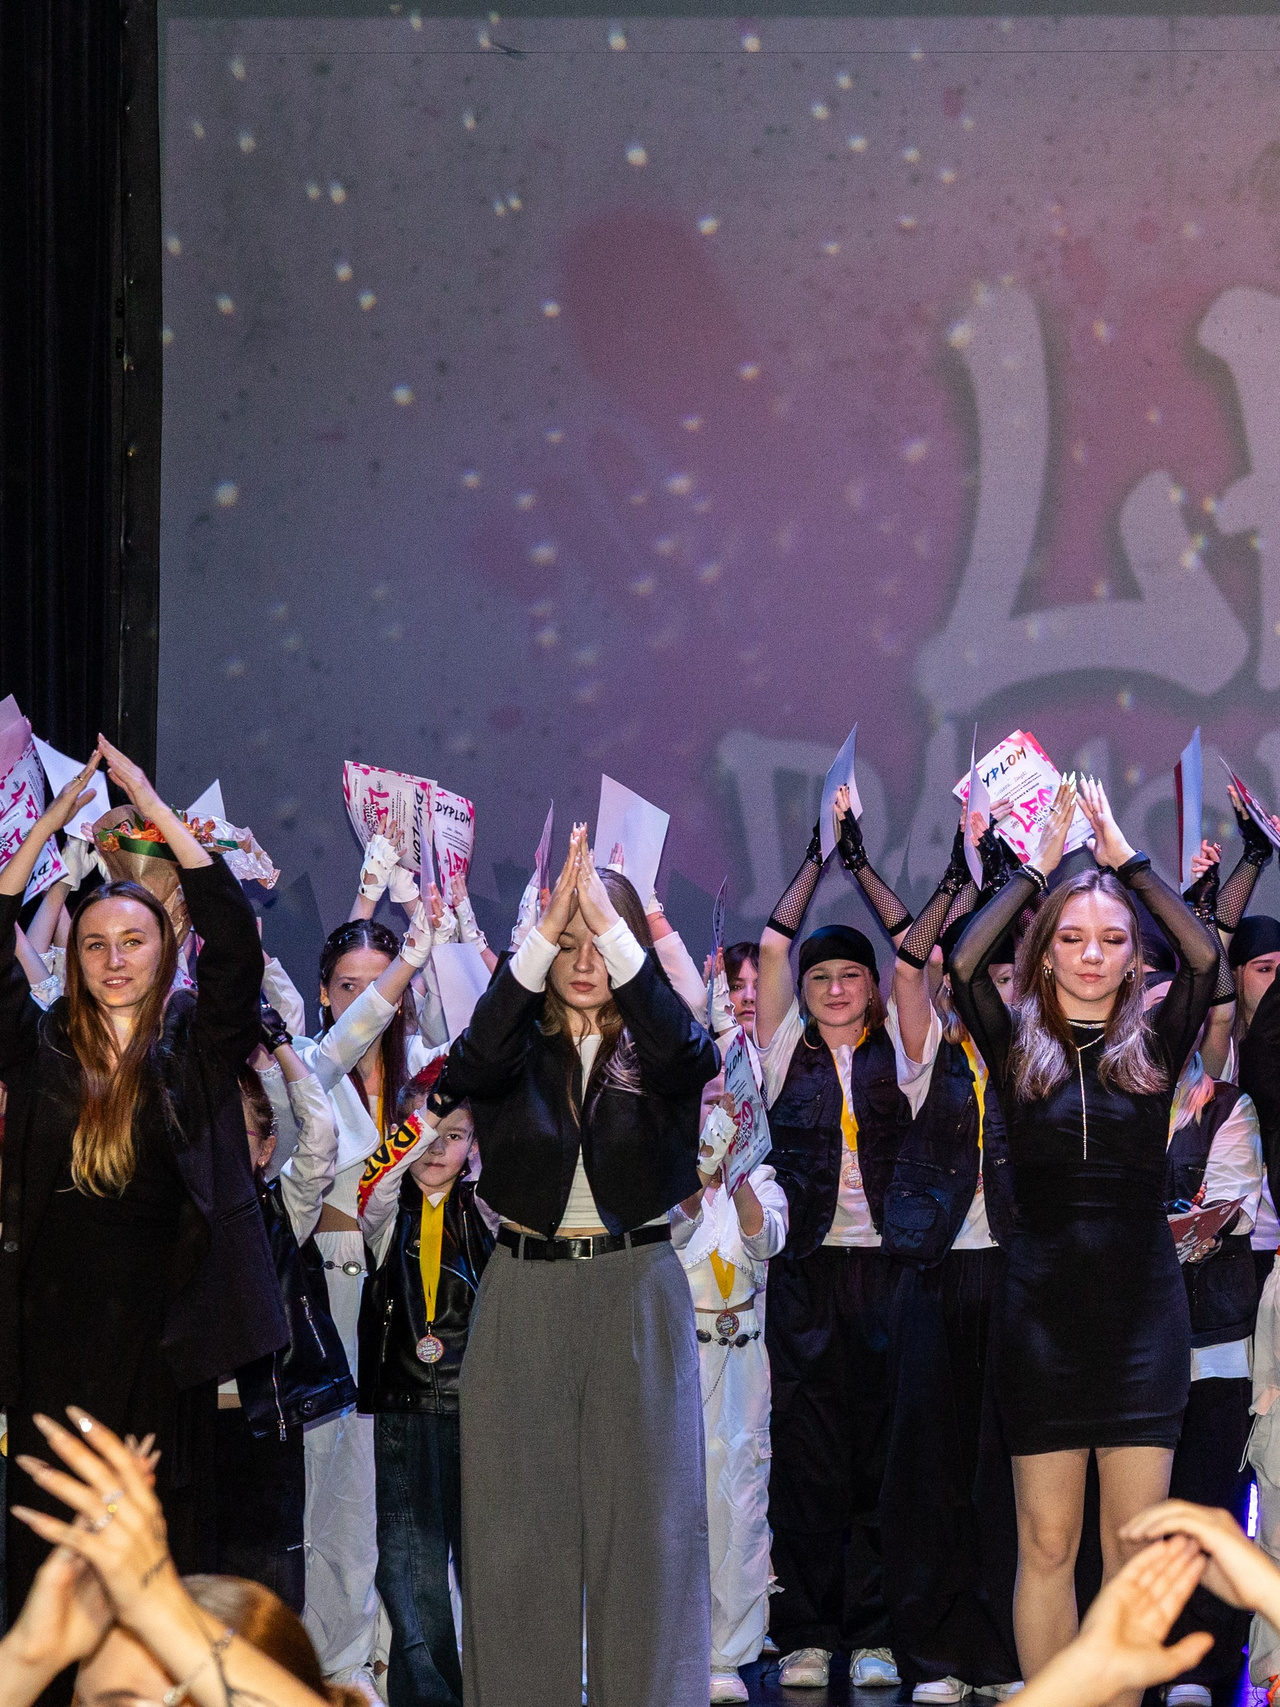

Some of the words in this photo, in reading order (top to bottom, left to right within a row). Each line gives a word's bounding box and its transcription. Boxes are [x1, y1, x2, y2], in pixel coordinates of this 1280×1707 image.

[982, 746, 1027, 787] YPLOM
[364, 786, 390, 836] LE
[435, 800, 471, 827] DYPLOM
